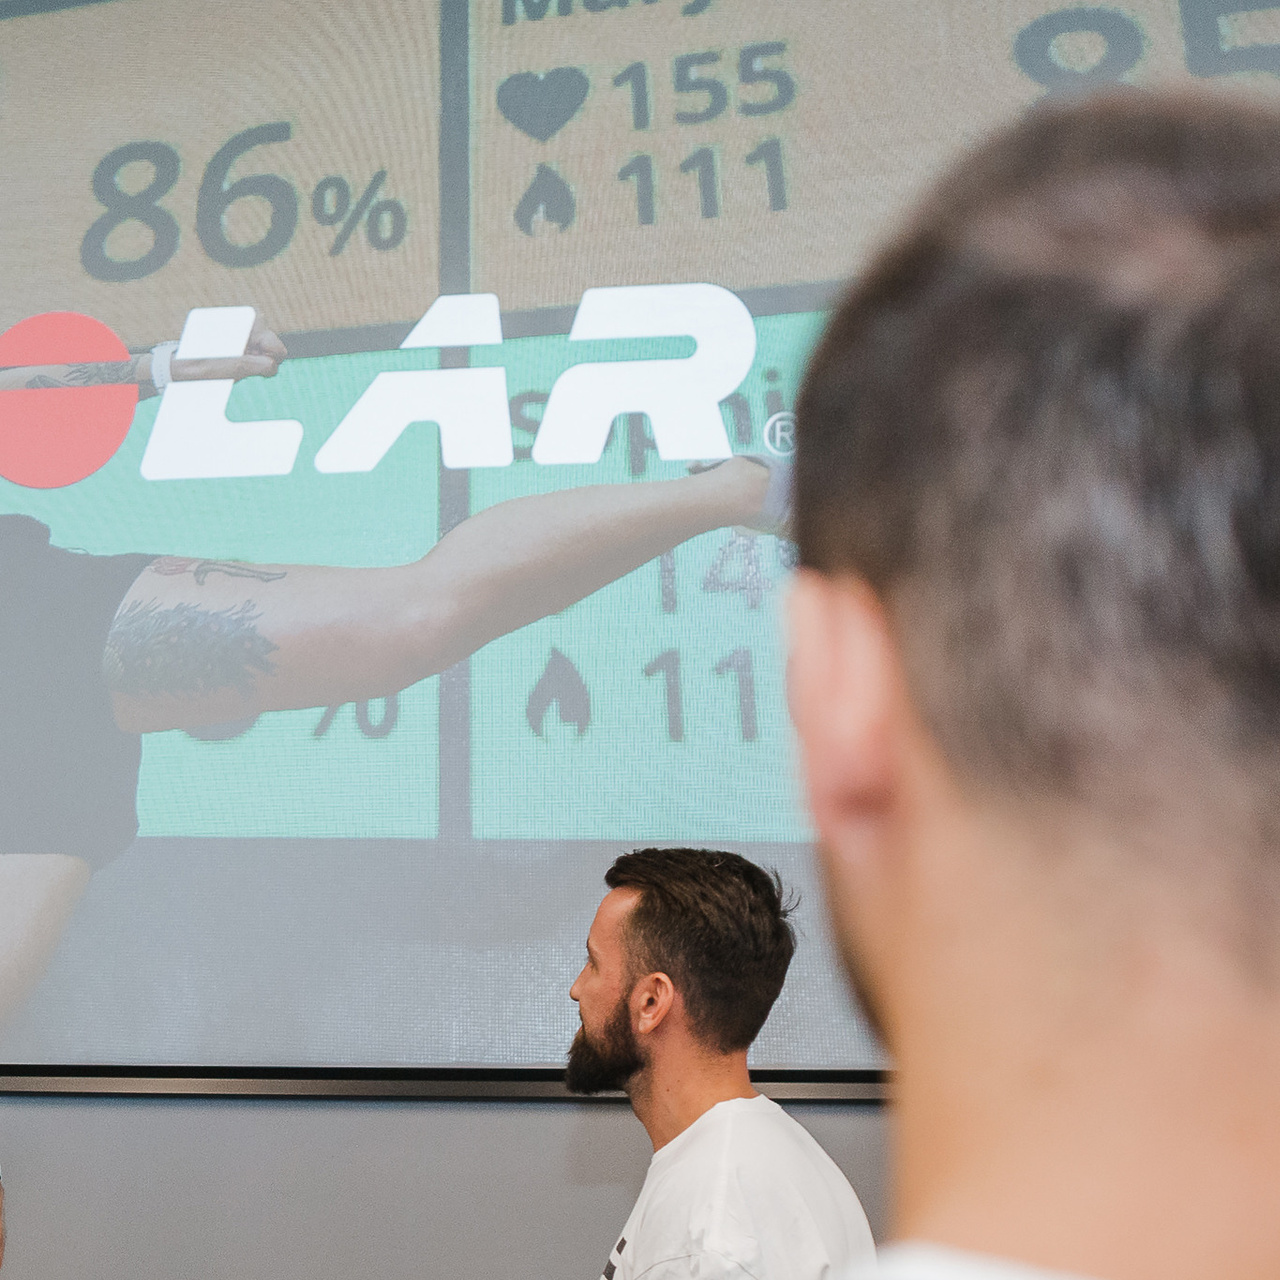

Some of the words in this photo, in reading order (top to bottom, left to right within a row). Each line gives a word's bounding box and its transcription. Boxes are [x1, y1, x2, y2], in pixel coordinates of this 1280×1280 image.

[613, 41, 798, 131] 155
[79, 121, 410, 283] 86%
[618, 137, 789, 226] 111
[659, 532, 798, 614] 14
